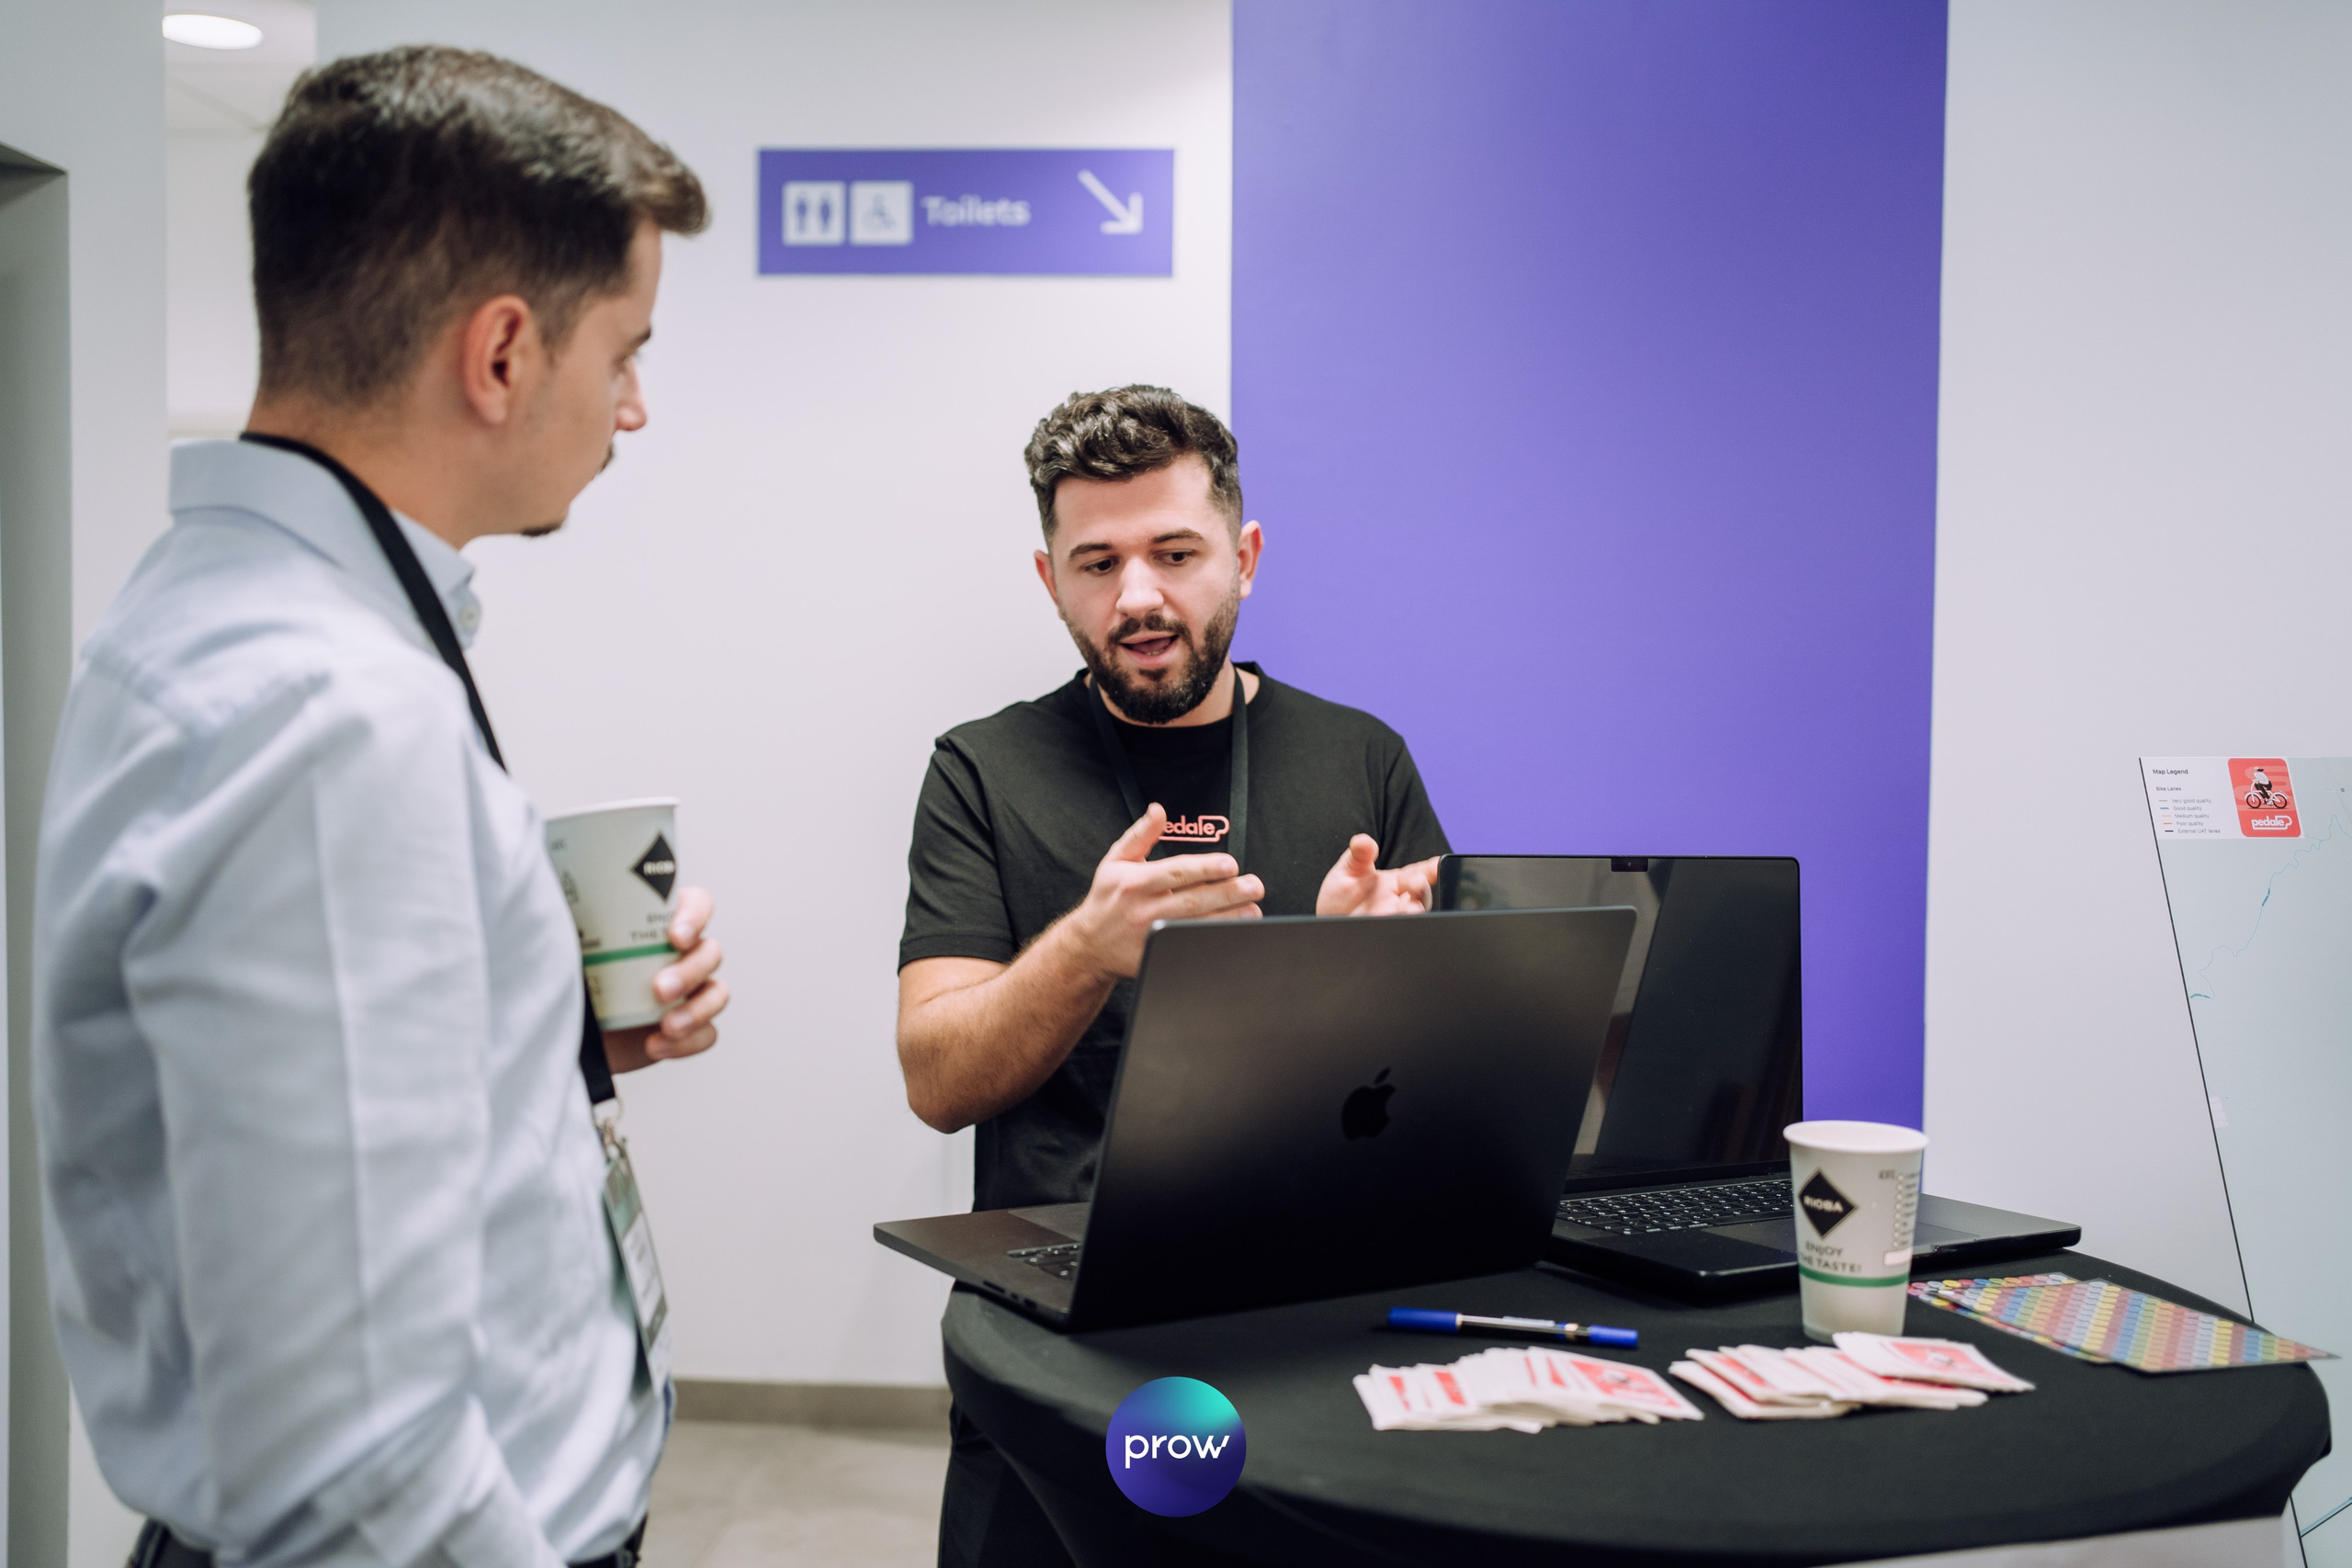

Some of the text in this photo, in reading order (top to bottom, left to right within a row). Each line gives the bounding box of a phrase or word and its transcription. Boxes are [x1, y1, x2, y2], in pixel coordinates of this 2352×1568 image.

[921, 195, 1031, 226] Toilets
[1163, 815, 1220, 839] edale
[2251, 815, 2290, 829] pedale
[644, 861, 675, 875] RIOB
[1804, 1195, 1844, 1213] RIOBA
[1805, 1241, 1843, 1257] ENJOY
[1817, 1258, 1862, 1272] TASTE!
